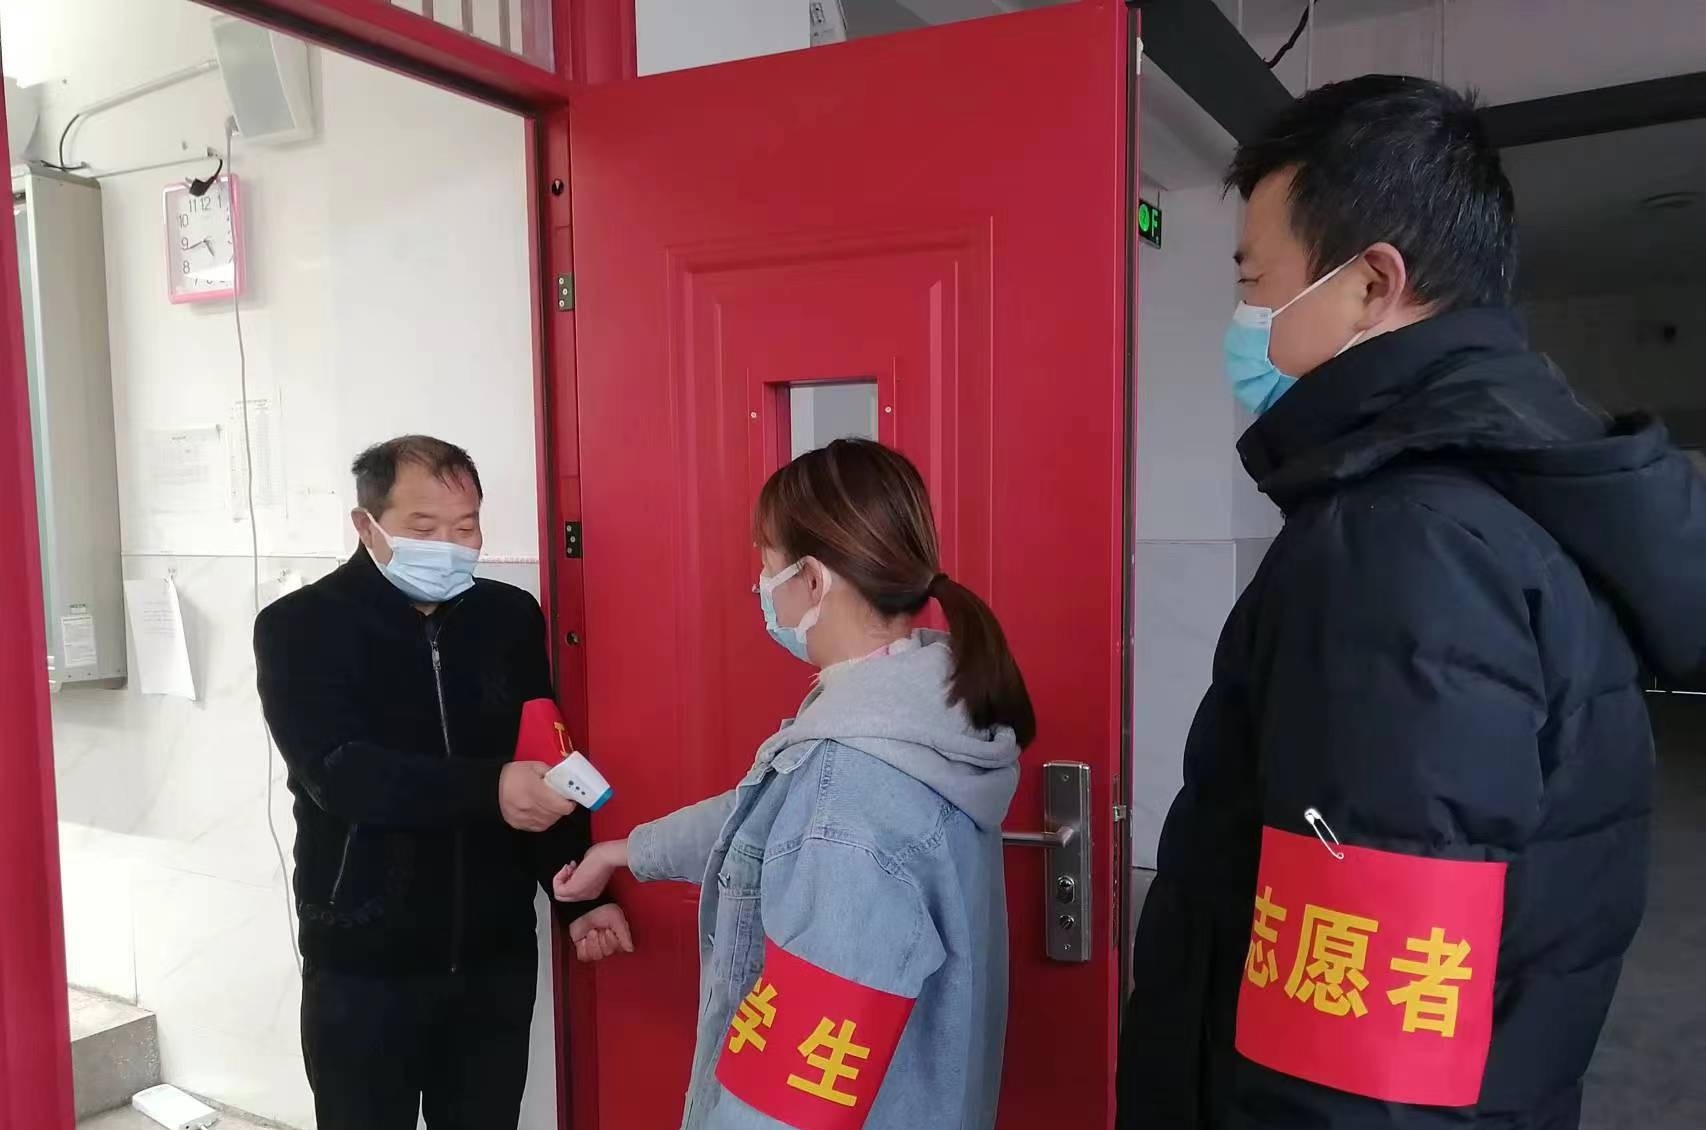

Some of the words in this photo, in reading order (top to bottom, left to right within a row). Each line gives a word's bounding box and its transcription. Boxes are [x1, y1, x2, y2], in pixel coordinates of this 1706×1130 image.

[200, 197, 211, 211] 12
[179, 214, 189, 228] 10
[180, 237, 189, 250] 9
[183, 260, 191, 274] 8
[1245, 885, 1473, 1037] 志愿者
[728, 977, 871, 1107] 学生
